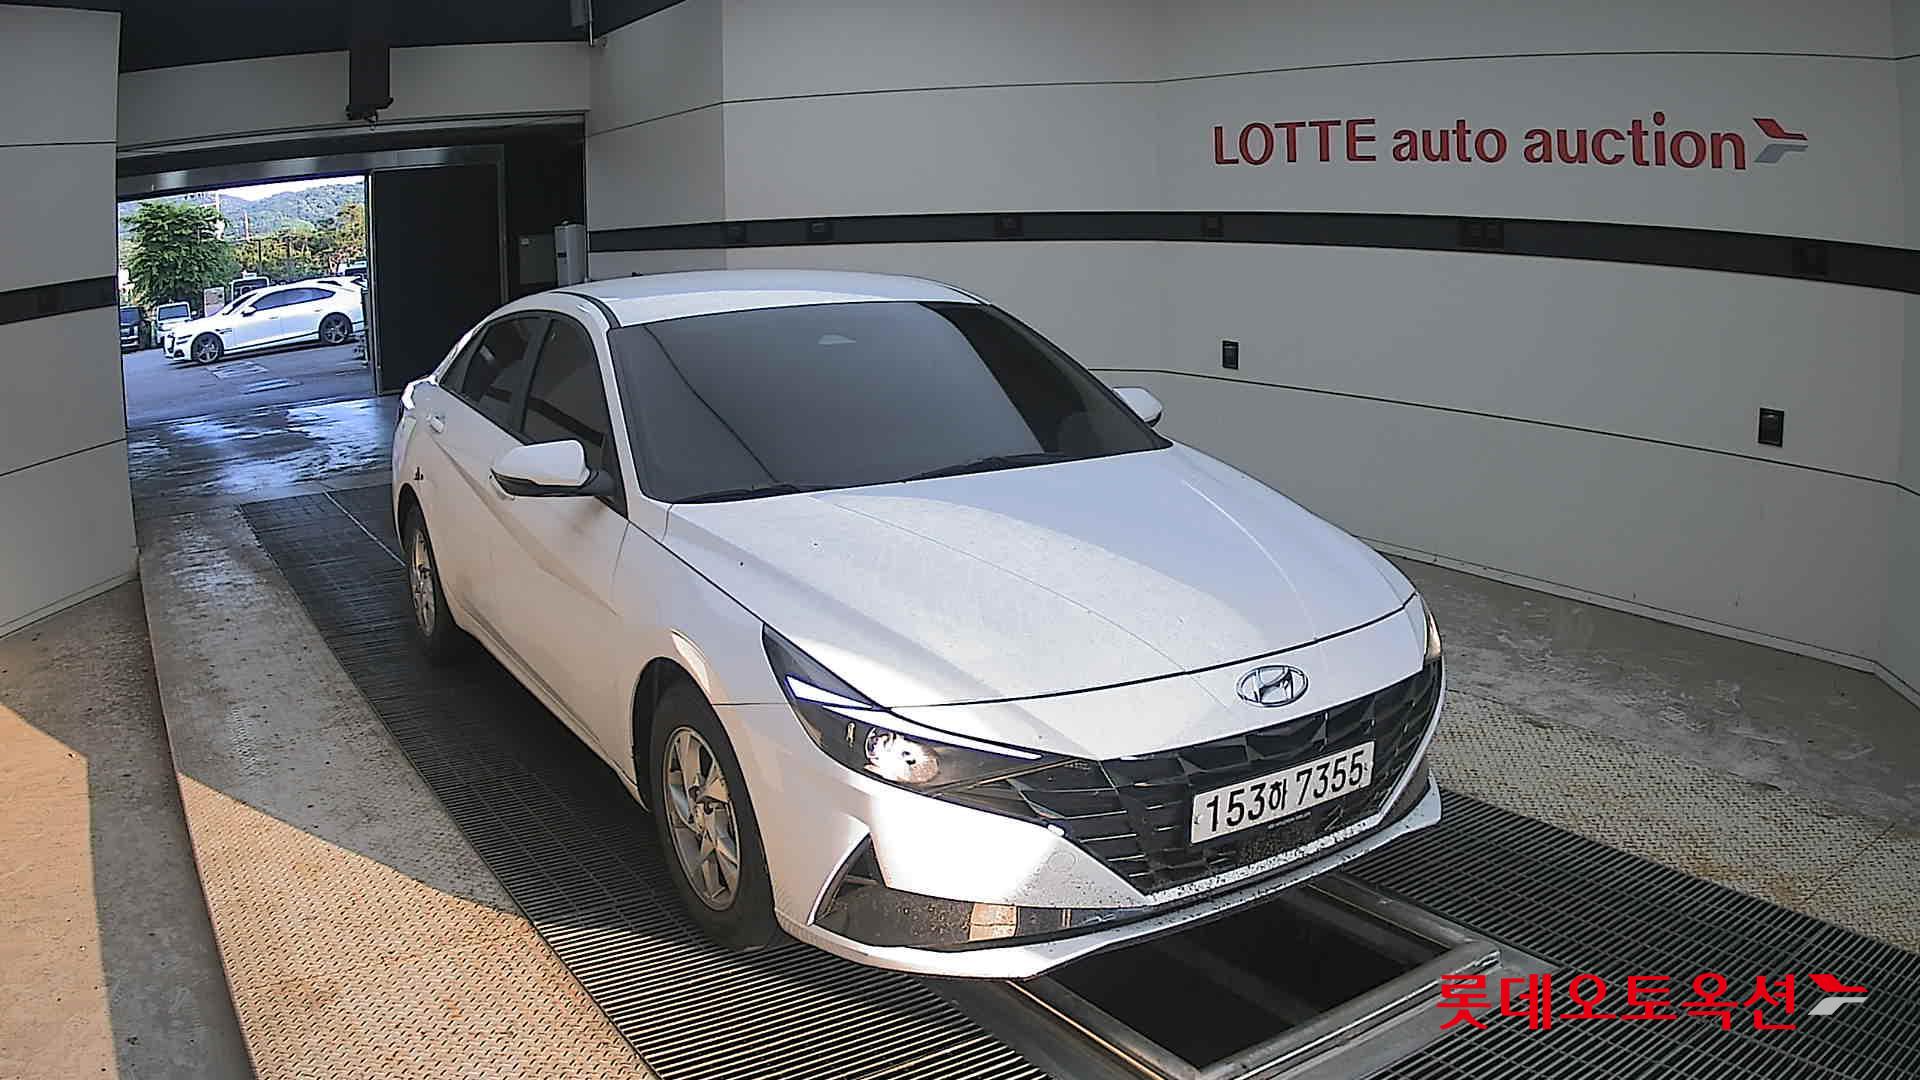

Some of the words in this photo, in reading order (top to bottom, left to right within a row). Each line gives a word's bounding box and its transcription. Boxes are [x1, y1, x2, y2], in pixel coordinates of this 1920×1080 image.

[1213, 118, 1376, 165] LOTTE
[1392, 119, 1507, 163] auto
[1523, 112, 1747, 170] auction
[1206, 778, 1287, 832] 153하
[1295, 750, 1364, 806] 7355
